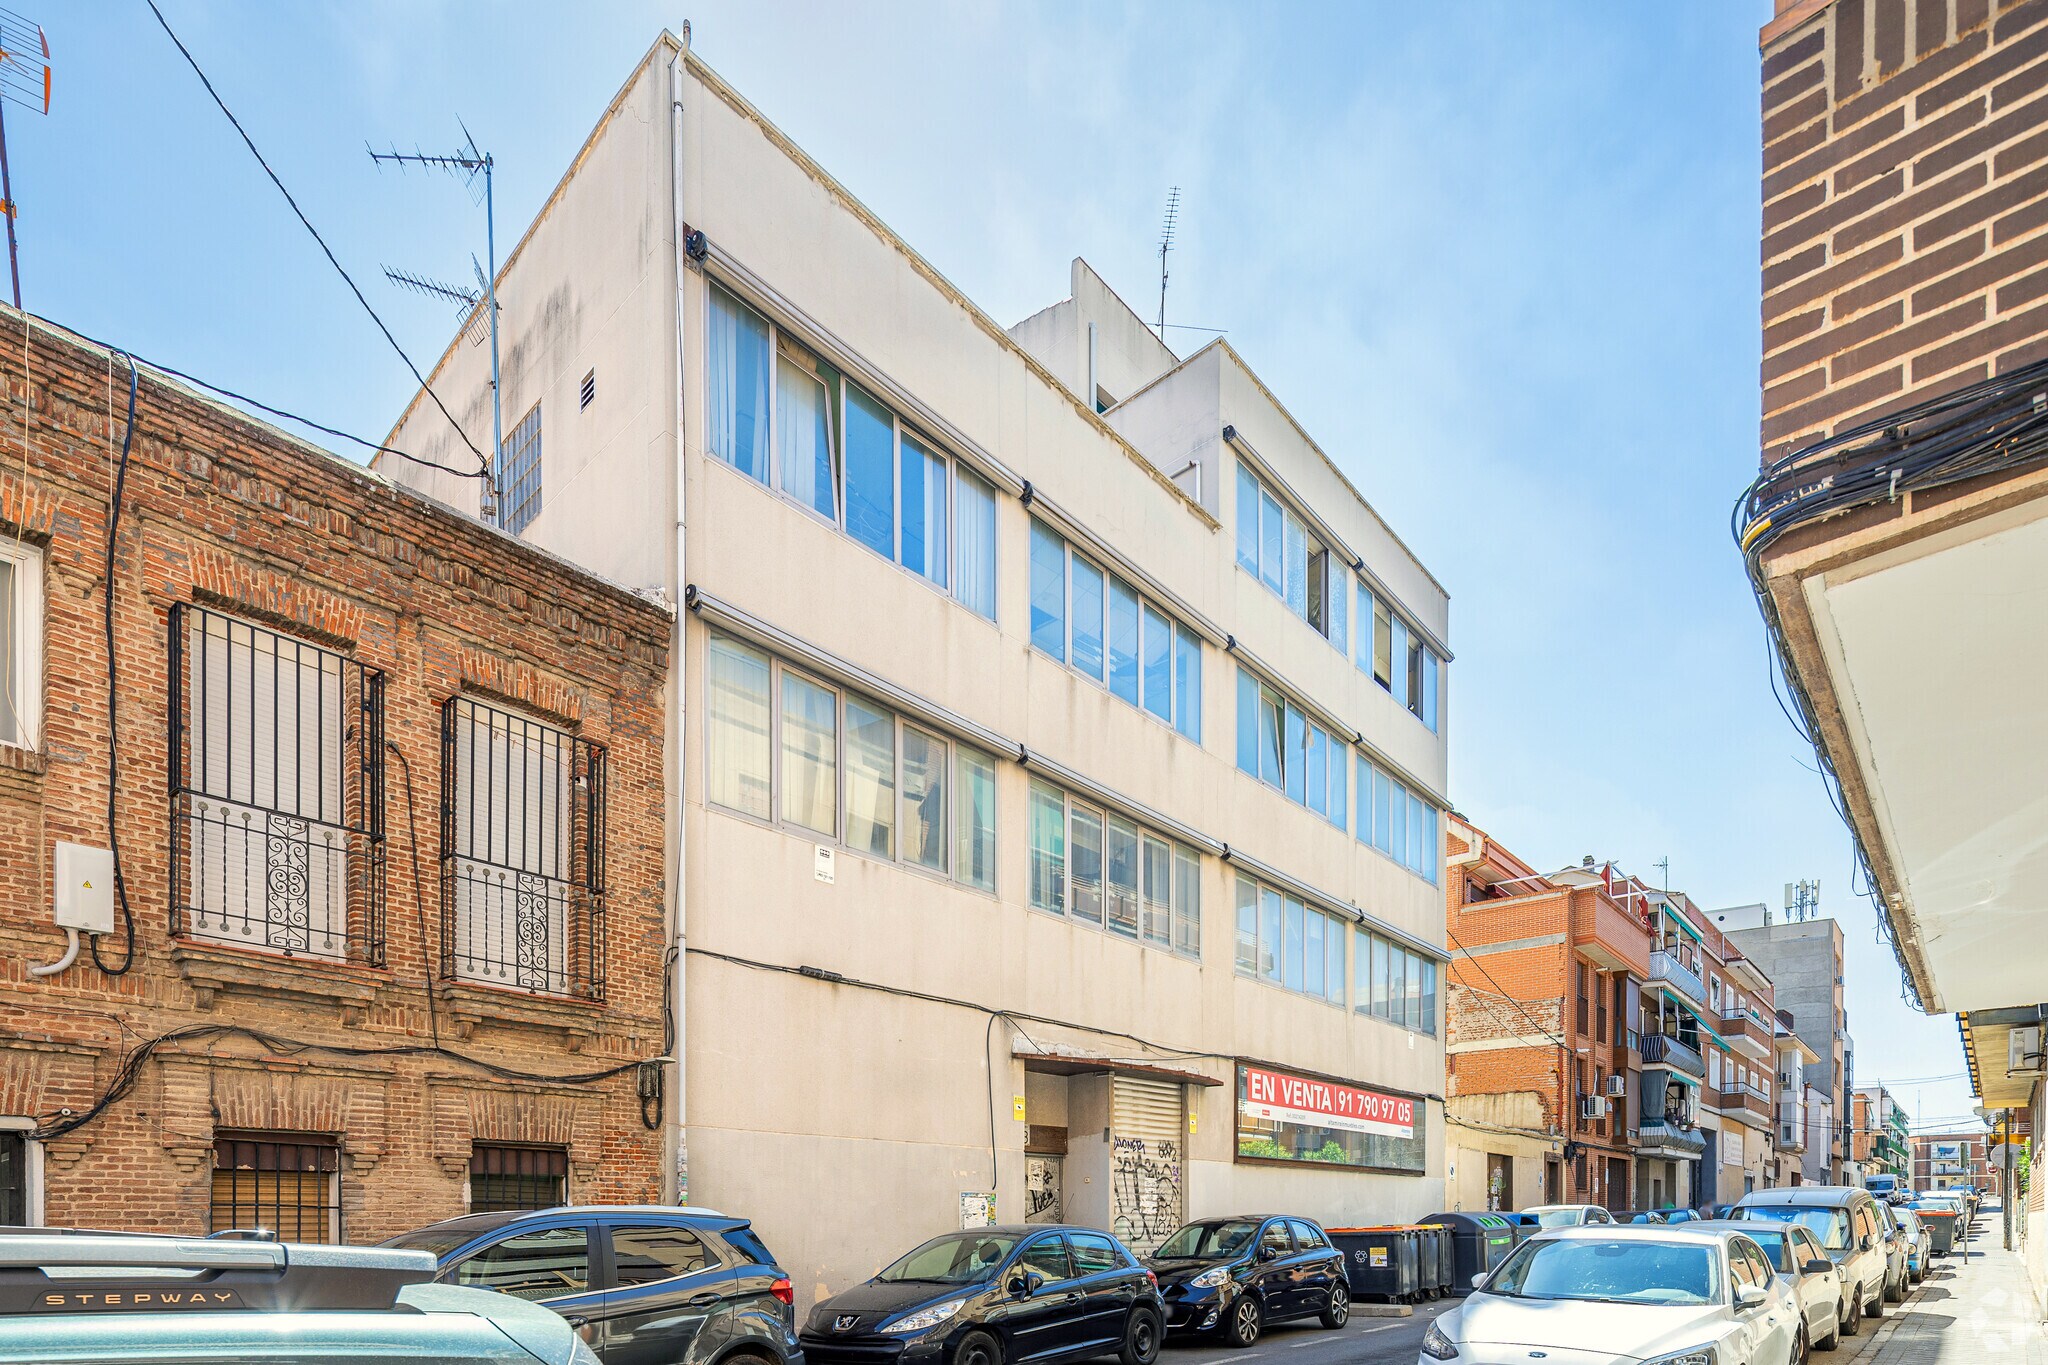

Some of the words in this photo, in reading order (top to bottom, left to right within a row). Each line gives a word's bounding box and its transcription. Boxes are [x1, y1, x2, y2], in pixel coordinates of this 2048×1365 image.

[1251, 1072, 1275, 1103] EN
[1281, 1078, 1333, 1112] VENTA
[1338, 1090, 1352, 1113] 91
[1357, 1094, 1378, 1118] 790
[1381, 1098, 1395, 1119] 97
[1398, 1102, 1411, 1123] 05
[45, 1293, 231, 1305] STEPWAY
